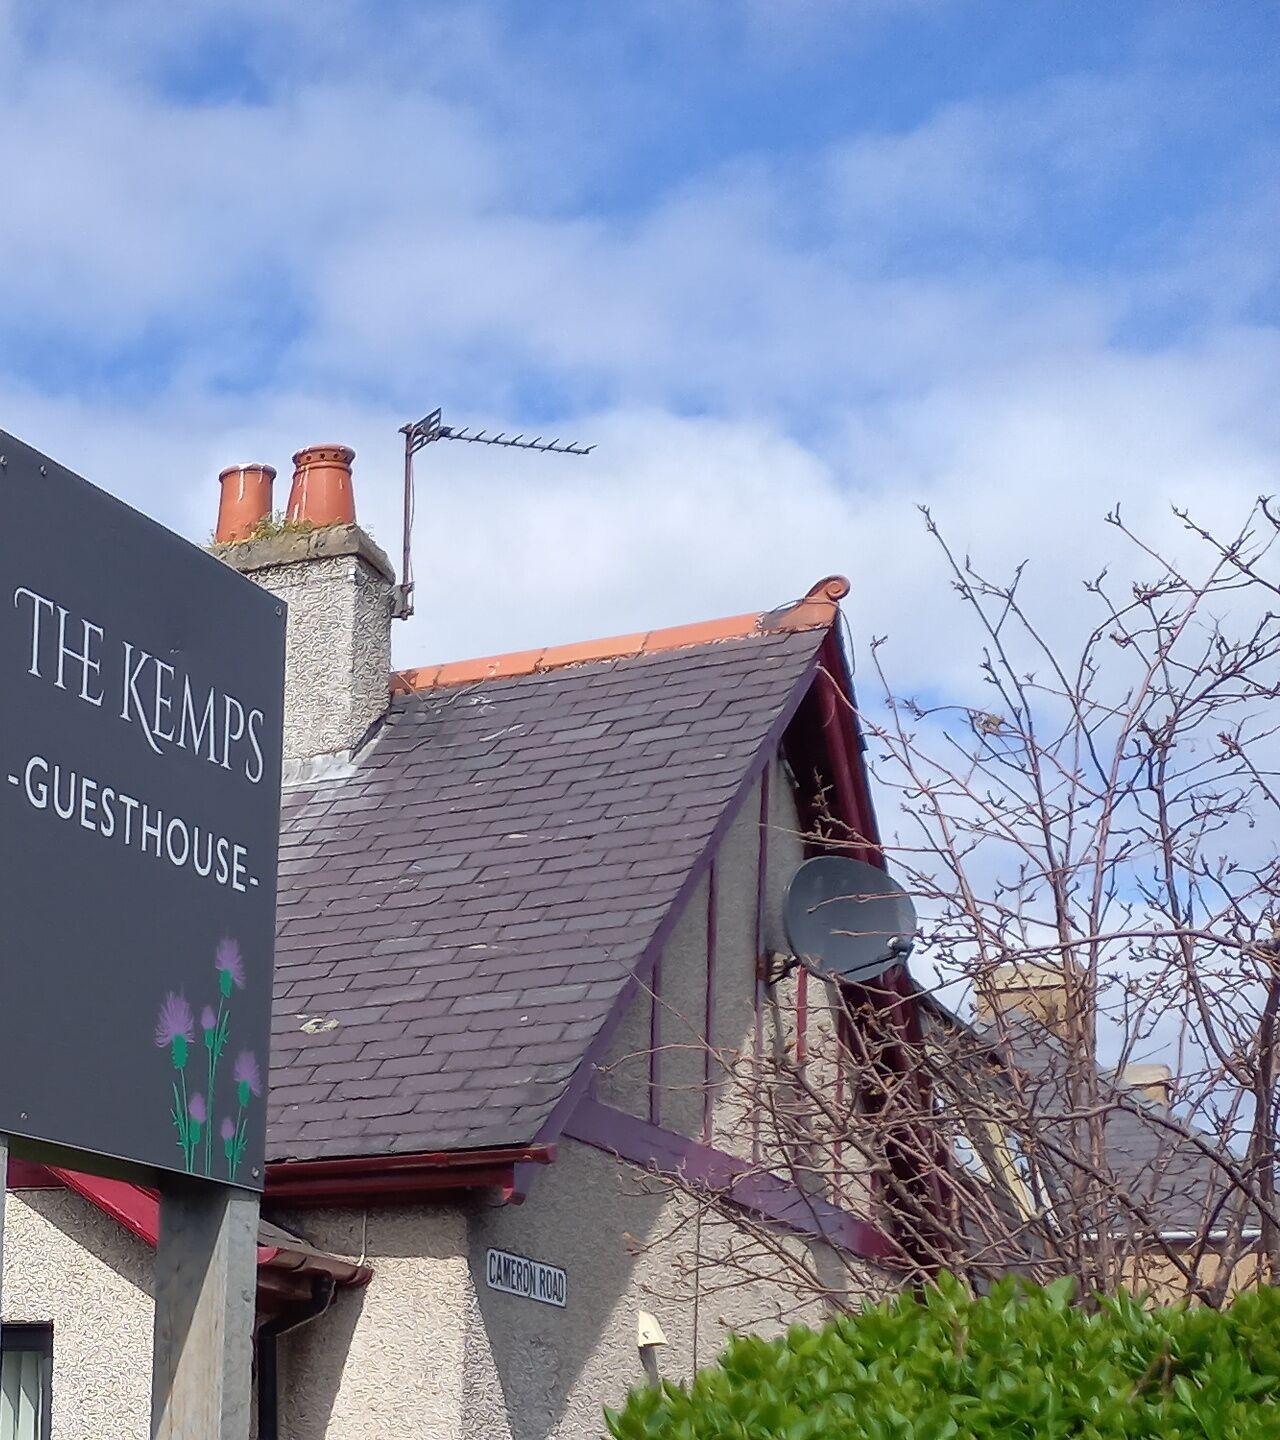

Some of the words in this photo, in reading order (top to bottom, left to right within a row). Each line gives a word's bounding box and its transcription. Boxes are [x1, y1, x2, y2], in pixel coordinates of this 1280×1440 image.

[14, 586, 105, 707] THE
[119, 640, 264, 784] KEMPS
[489, 1252, 537, 1296] CAMERON
[539, 1267, 565, 1303] ROAD
